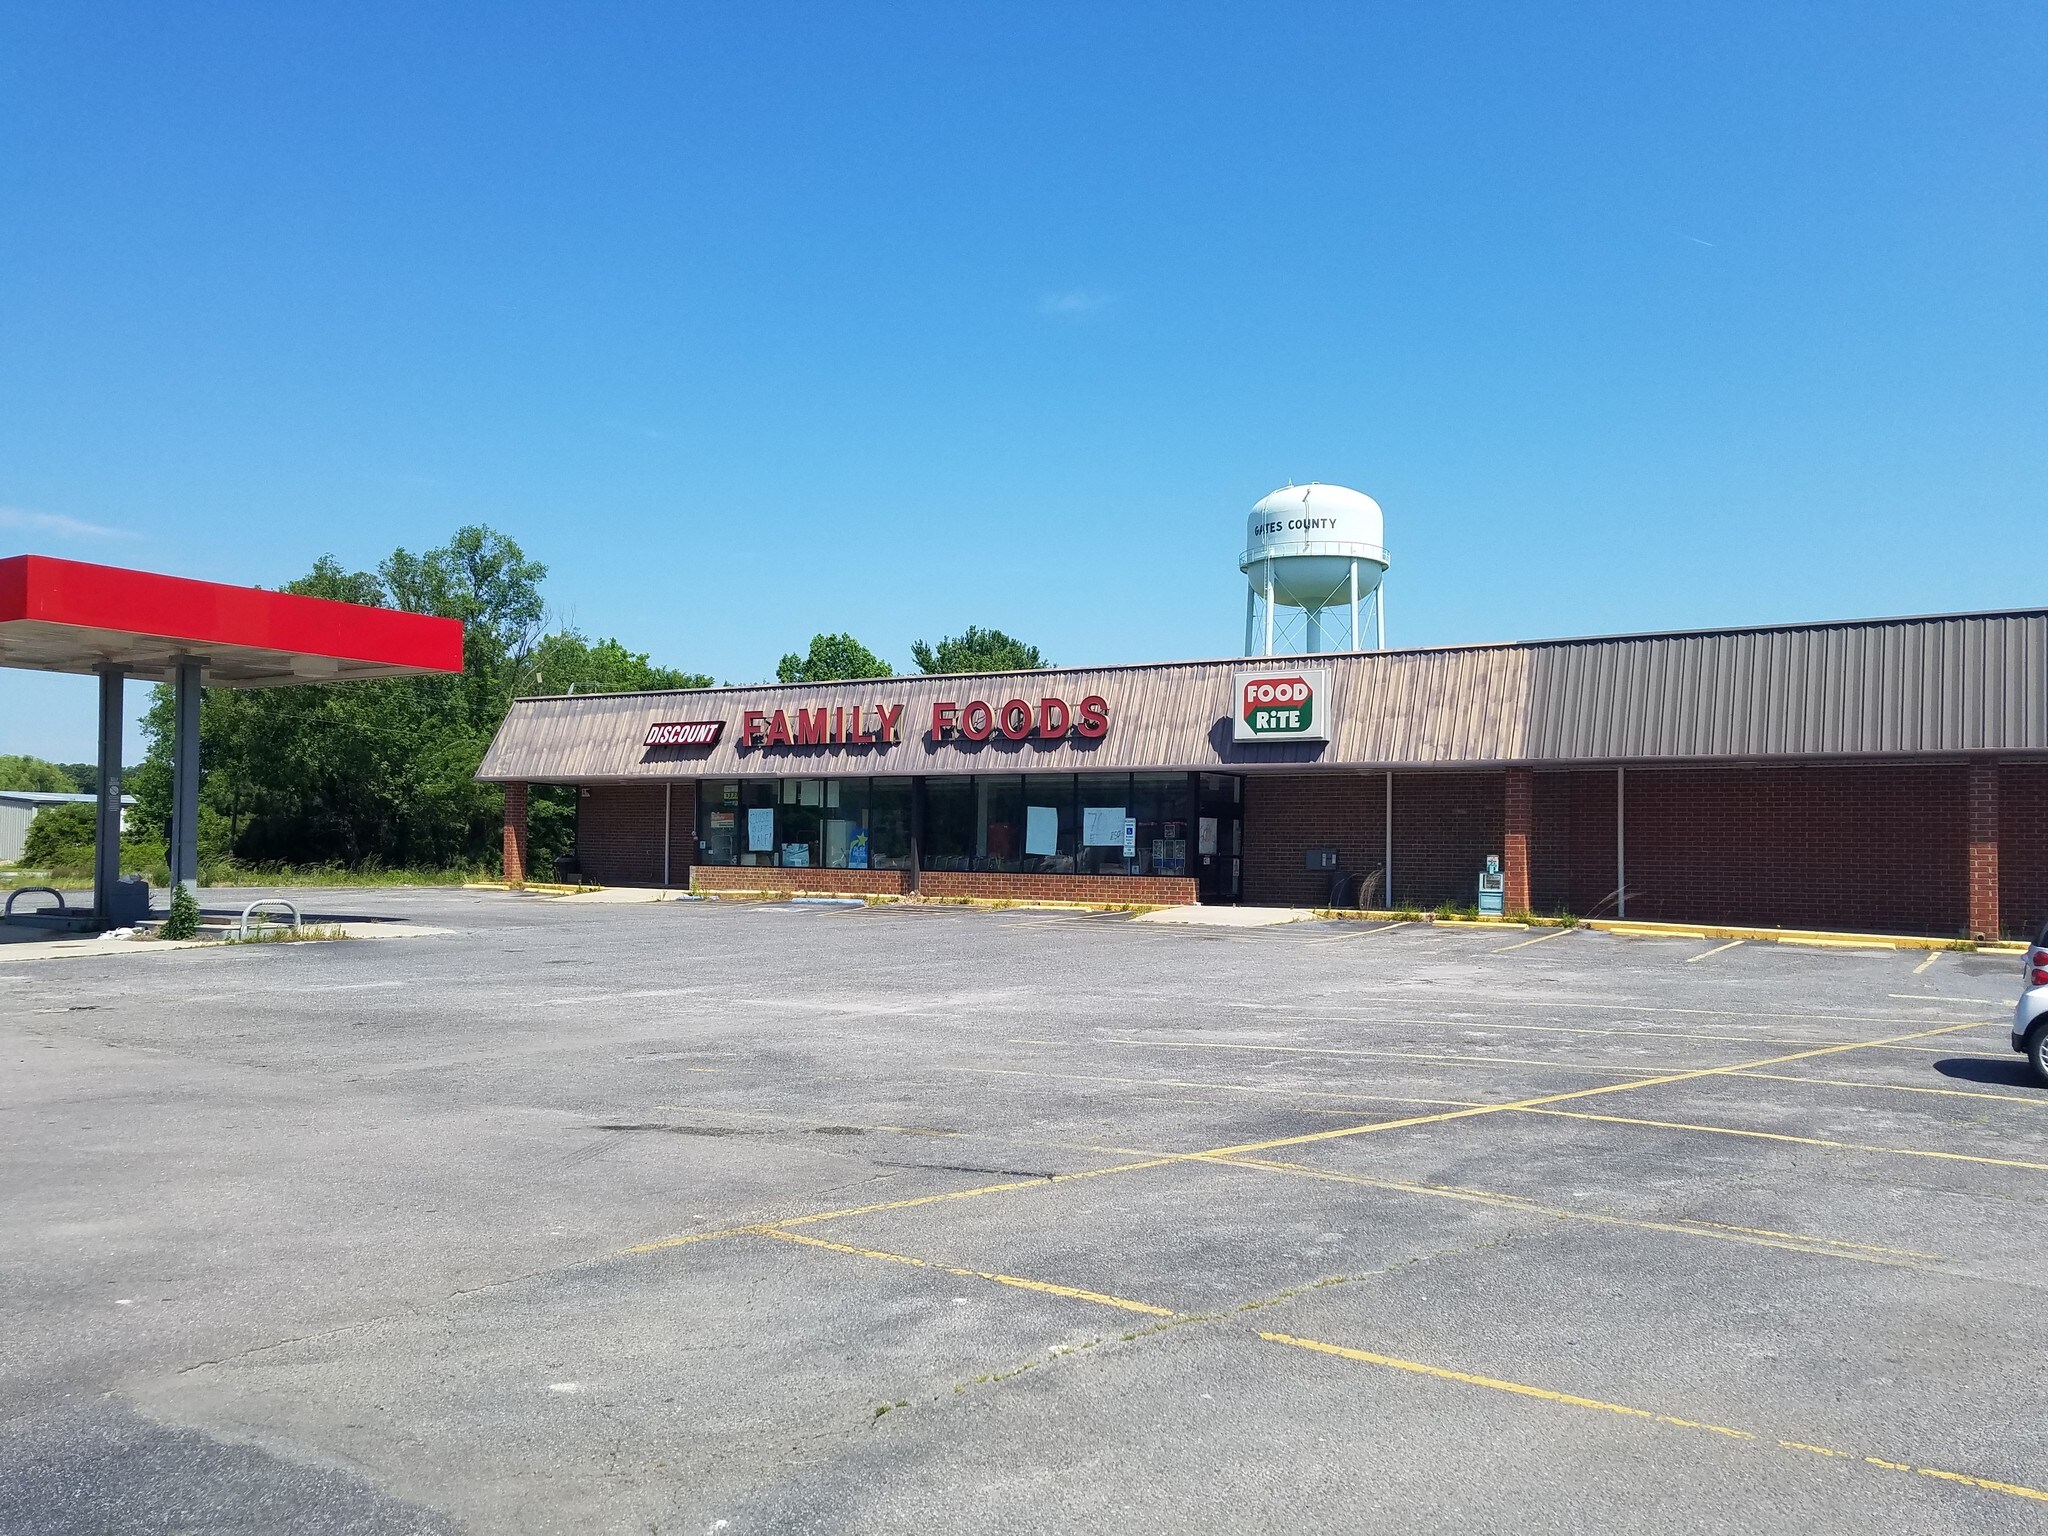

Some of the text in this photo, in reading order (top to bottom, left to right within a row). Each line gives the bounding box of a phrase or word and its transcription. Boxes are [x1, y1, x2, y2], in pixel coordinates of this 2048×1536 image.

[1288, 518, 1337, 530] COUNTY
[1247, 683, 1309, 703] FOOD
[743, 695, 1110, 746] FAMILY FOODS
[645, 724, 719, 744] DISCOUNT
